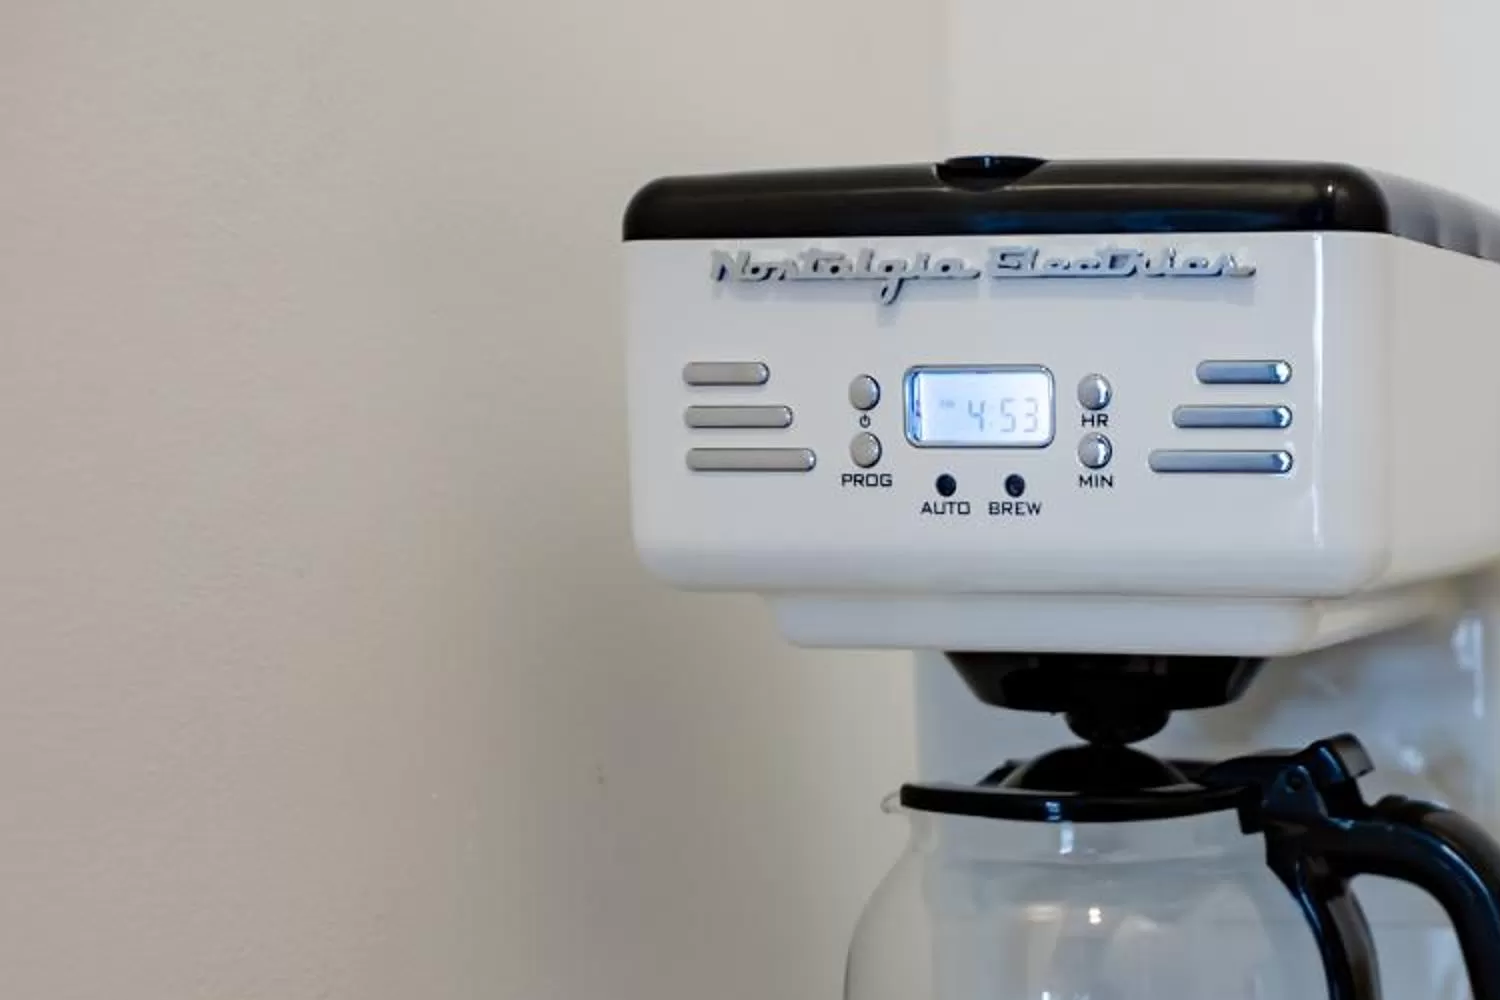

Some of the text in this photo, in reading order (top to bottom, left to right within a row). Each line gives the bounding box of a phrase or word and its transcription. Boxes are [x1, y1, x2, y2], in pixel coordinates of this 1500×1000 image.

[711, 247, 1258, 304] Nostalgia Electrics
[1081, 414, 1109, 427] HR
[841, 474, 892, 487] PROG
[1079, 476, 1113, 488] MIN
[920, 502, 970, 515] AUTO
[988, 502, 1042, 515] BREW
